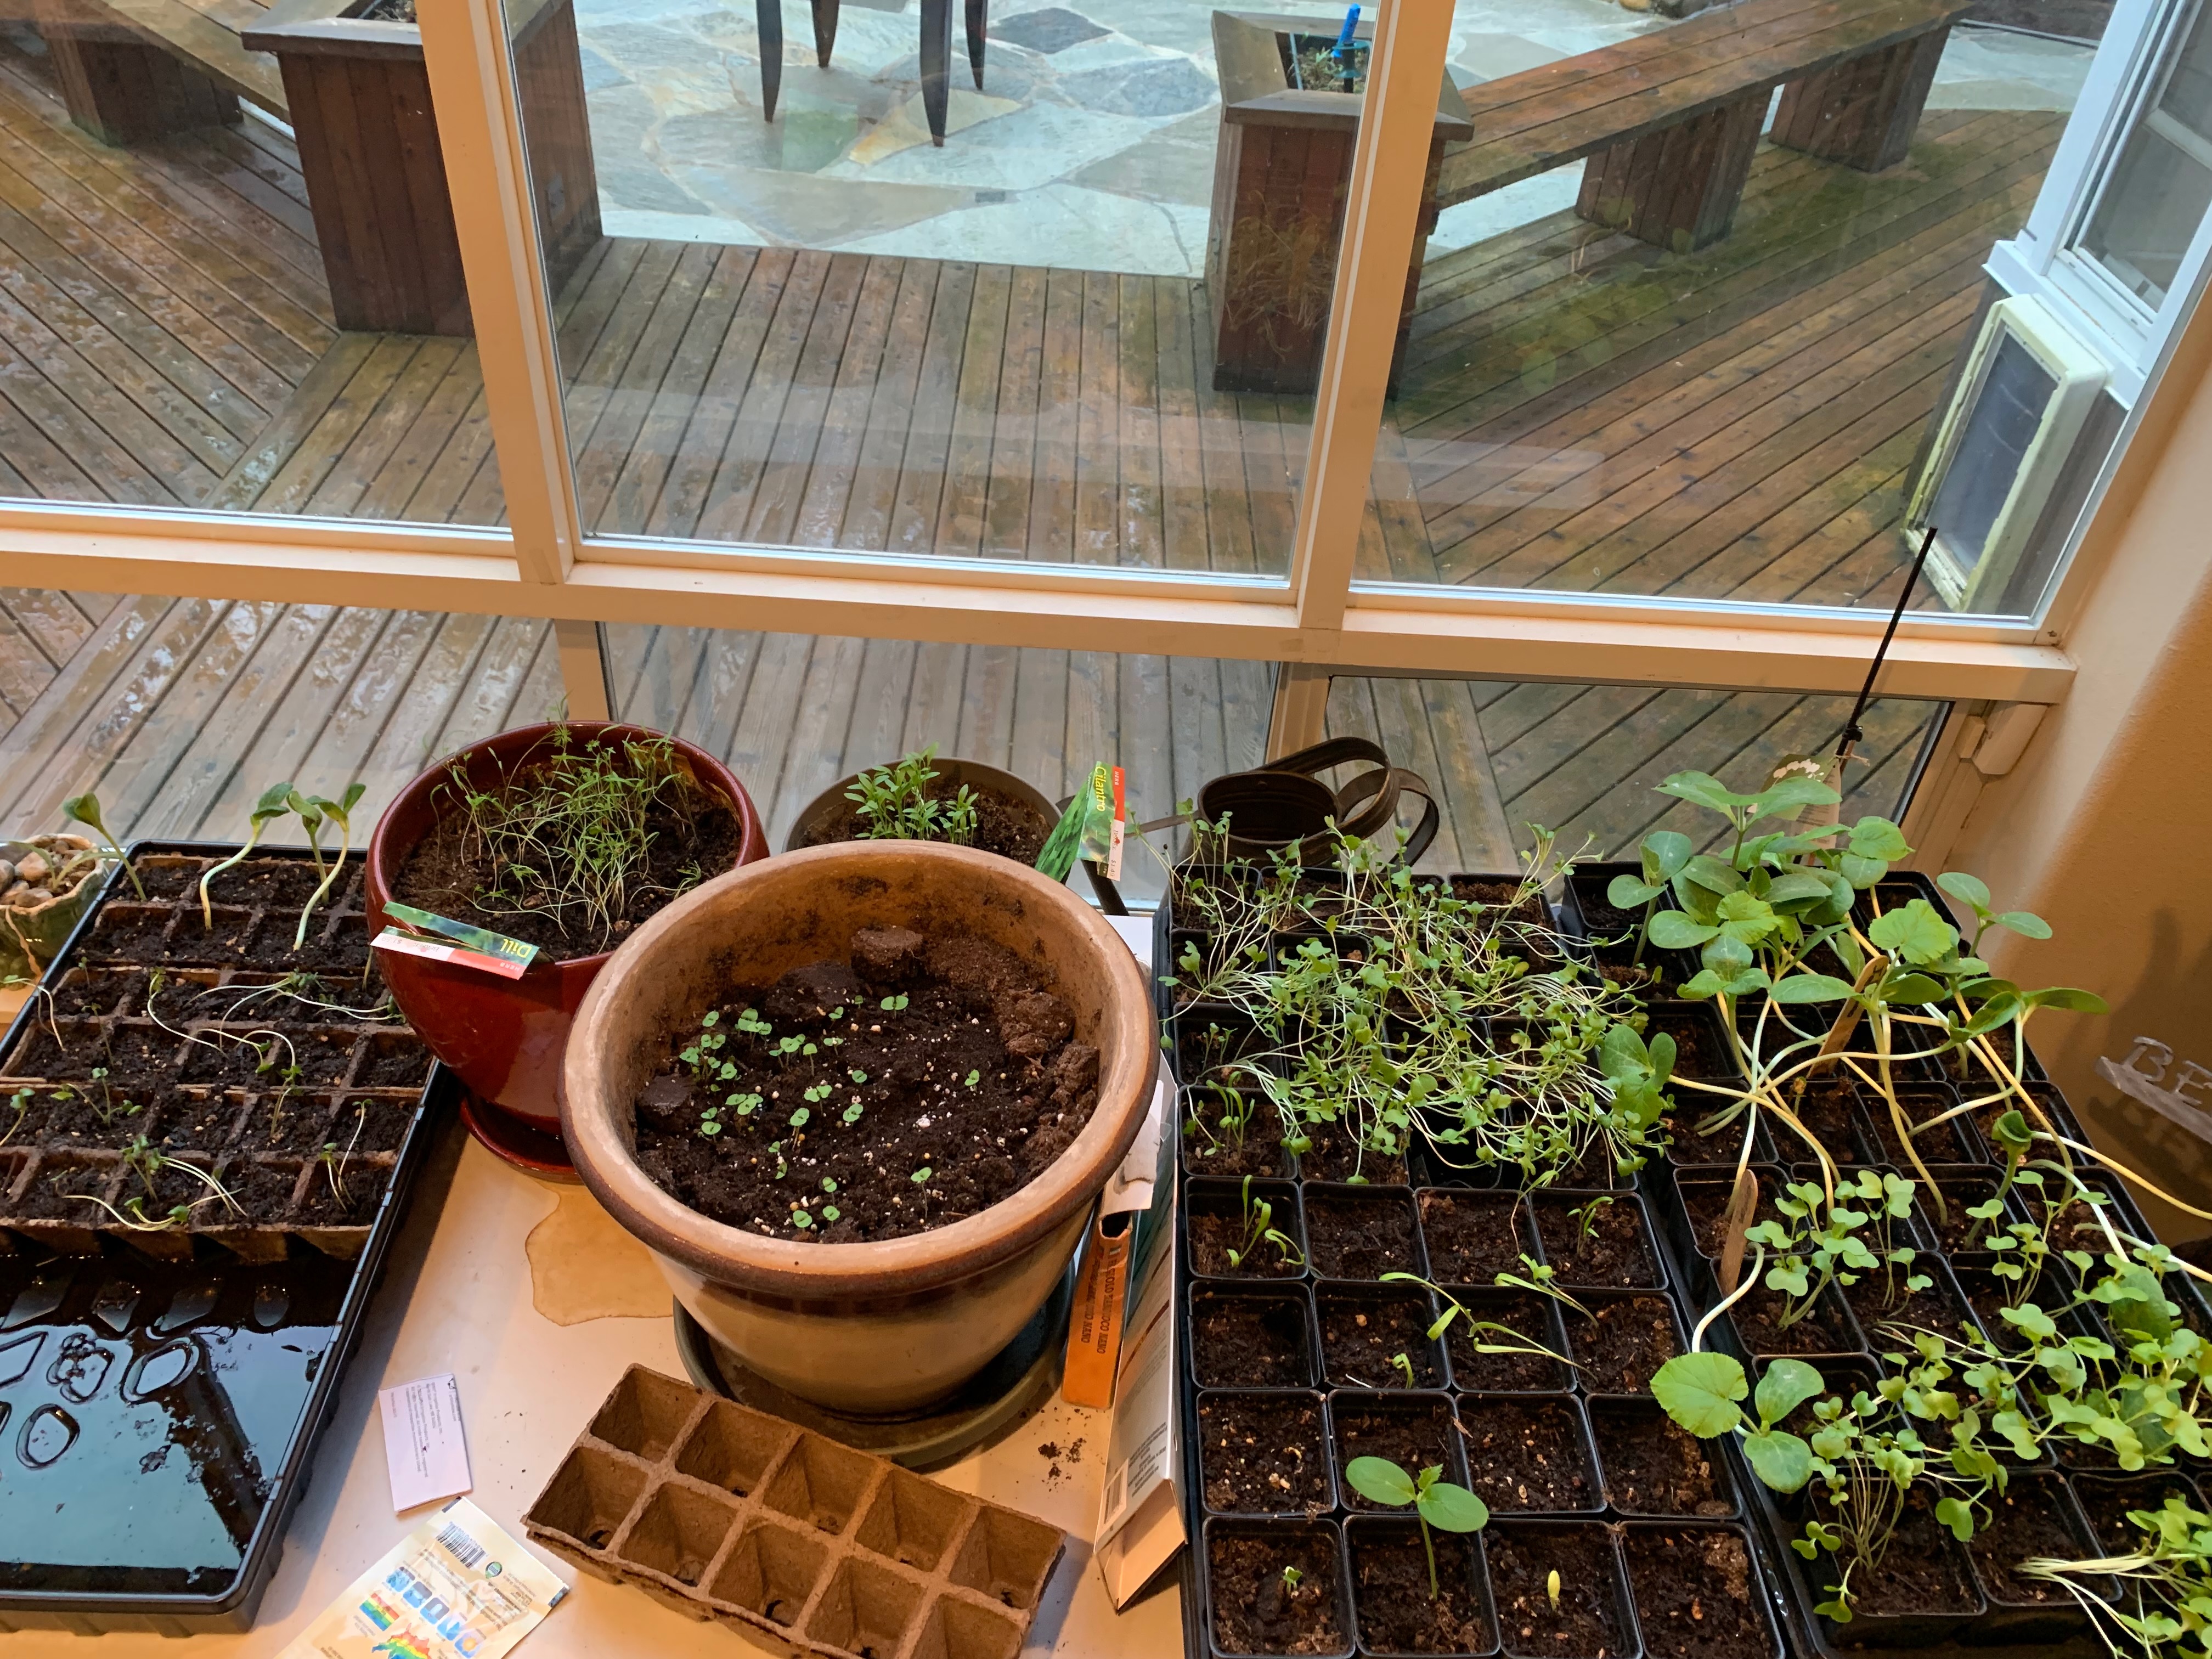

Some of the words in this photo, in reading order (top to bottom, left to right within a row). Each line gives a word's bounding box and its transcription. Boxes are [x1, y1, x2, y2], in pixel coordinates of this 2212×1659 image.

[1094, 766, 1107, 812] Cilantro
[500, 938, 533, 958] Dill
[499, 962, 520, 972] HERB
[2121, 1036, 2212, 1107] BE
